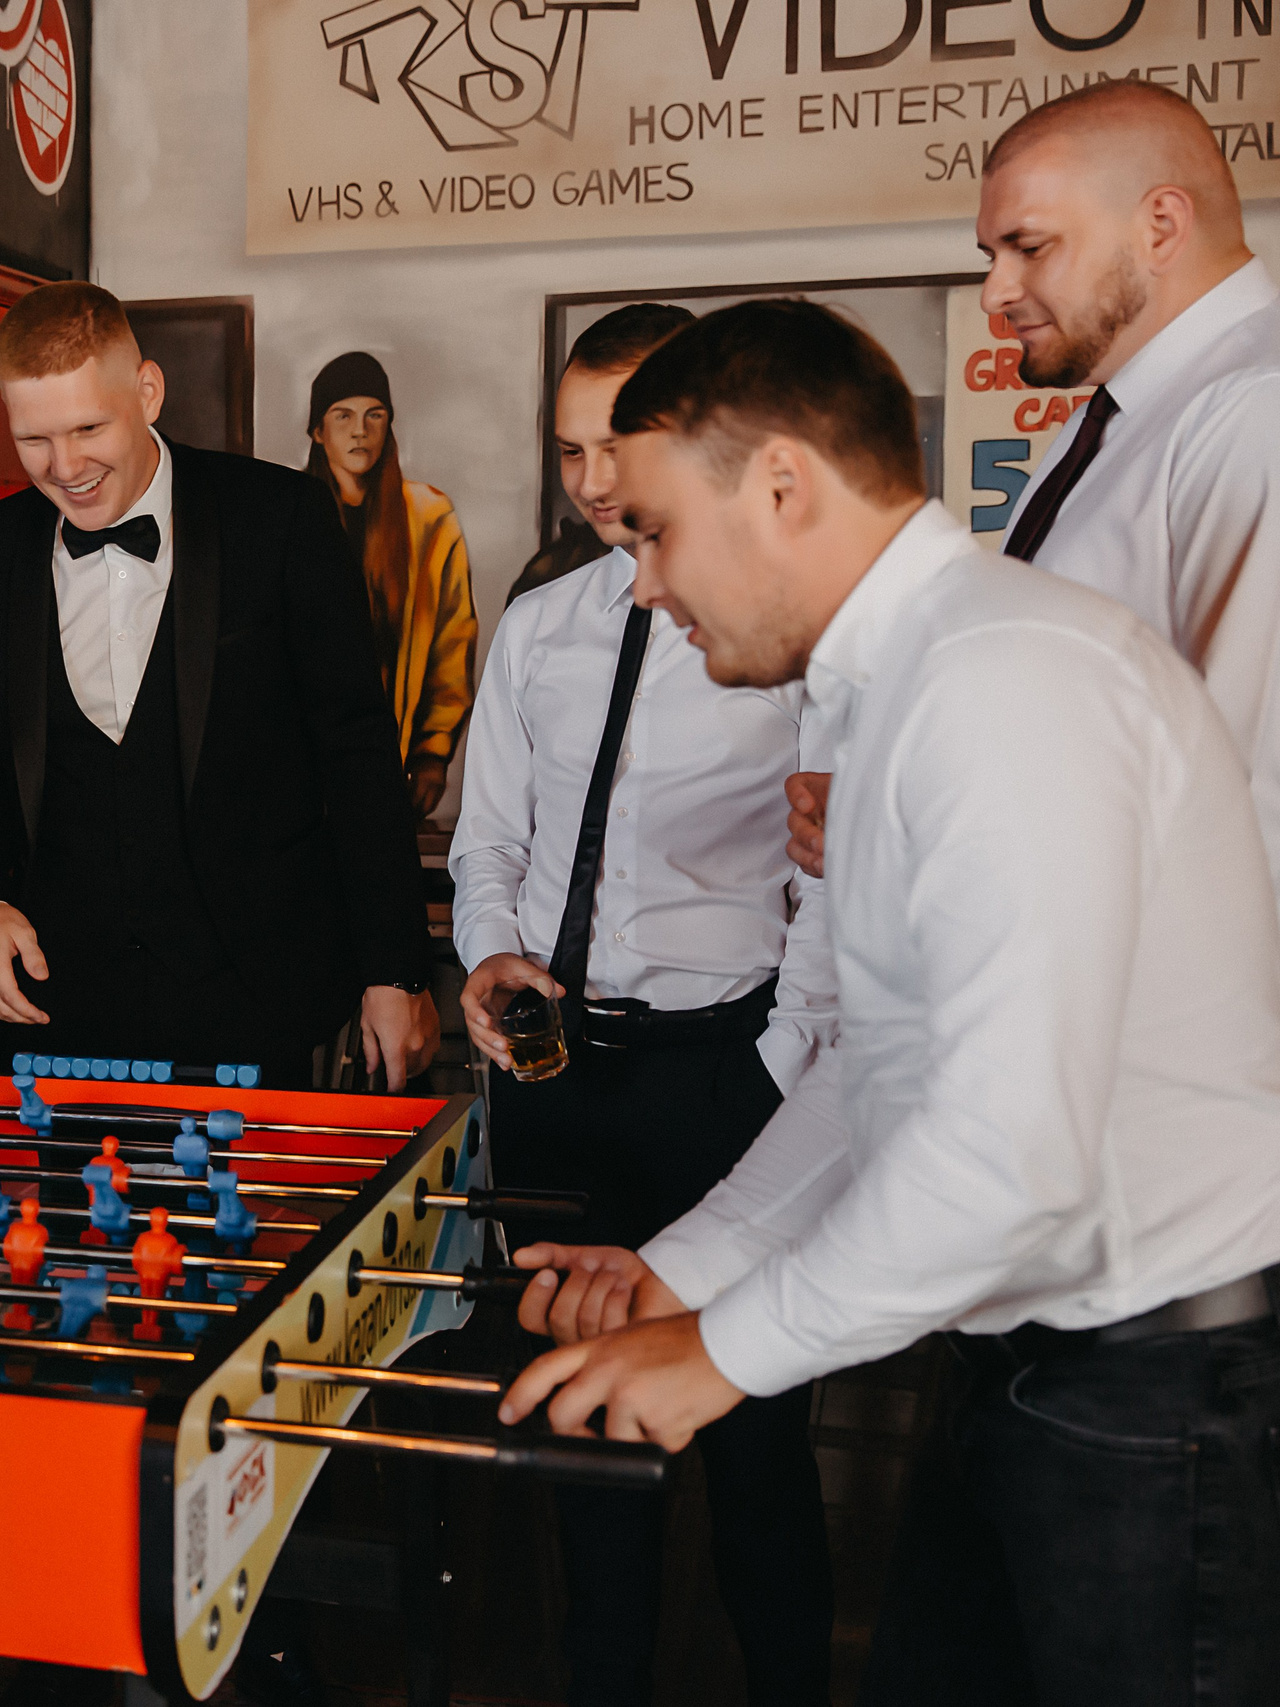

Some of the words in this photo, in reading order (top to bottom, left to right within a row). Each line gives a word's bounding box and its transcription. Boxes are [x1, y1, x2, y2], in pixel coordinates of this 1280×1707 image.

[628, 97, 766, 146] HOME
[798, 58, 1261, 135] ENTERTAIENT
[288, 183, 364, 223] VHS
[375, 180, 400, 218] &
[420, 173, 536, 214] VIDEO
[552, 162, 695, 207] GAMES
